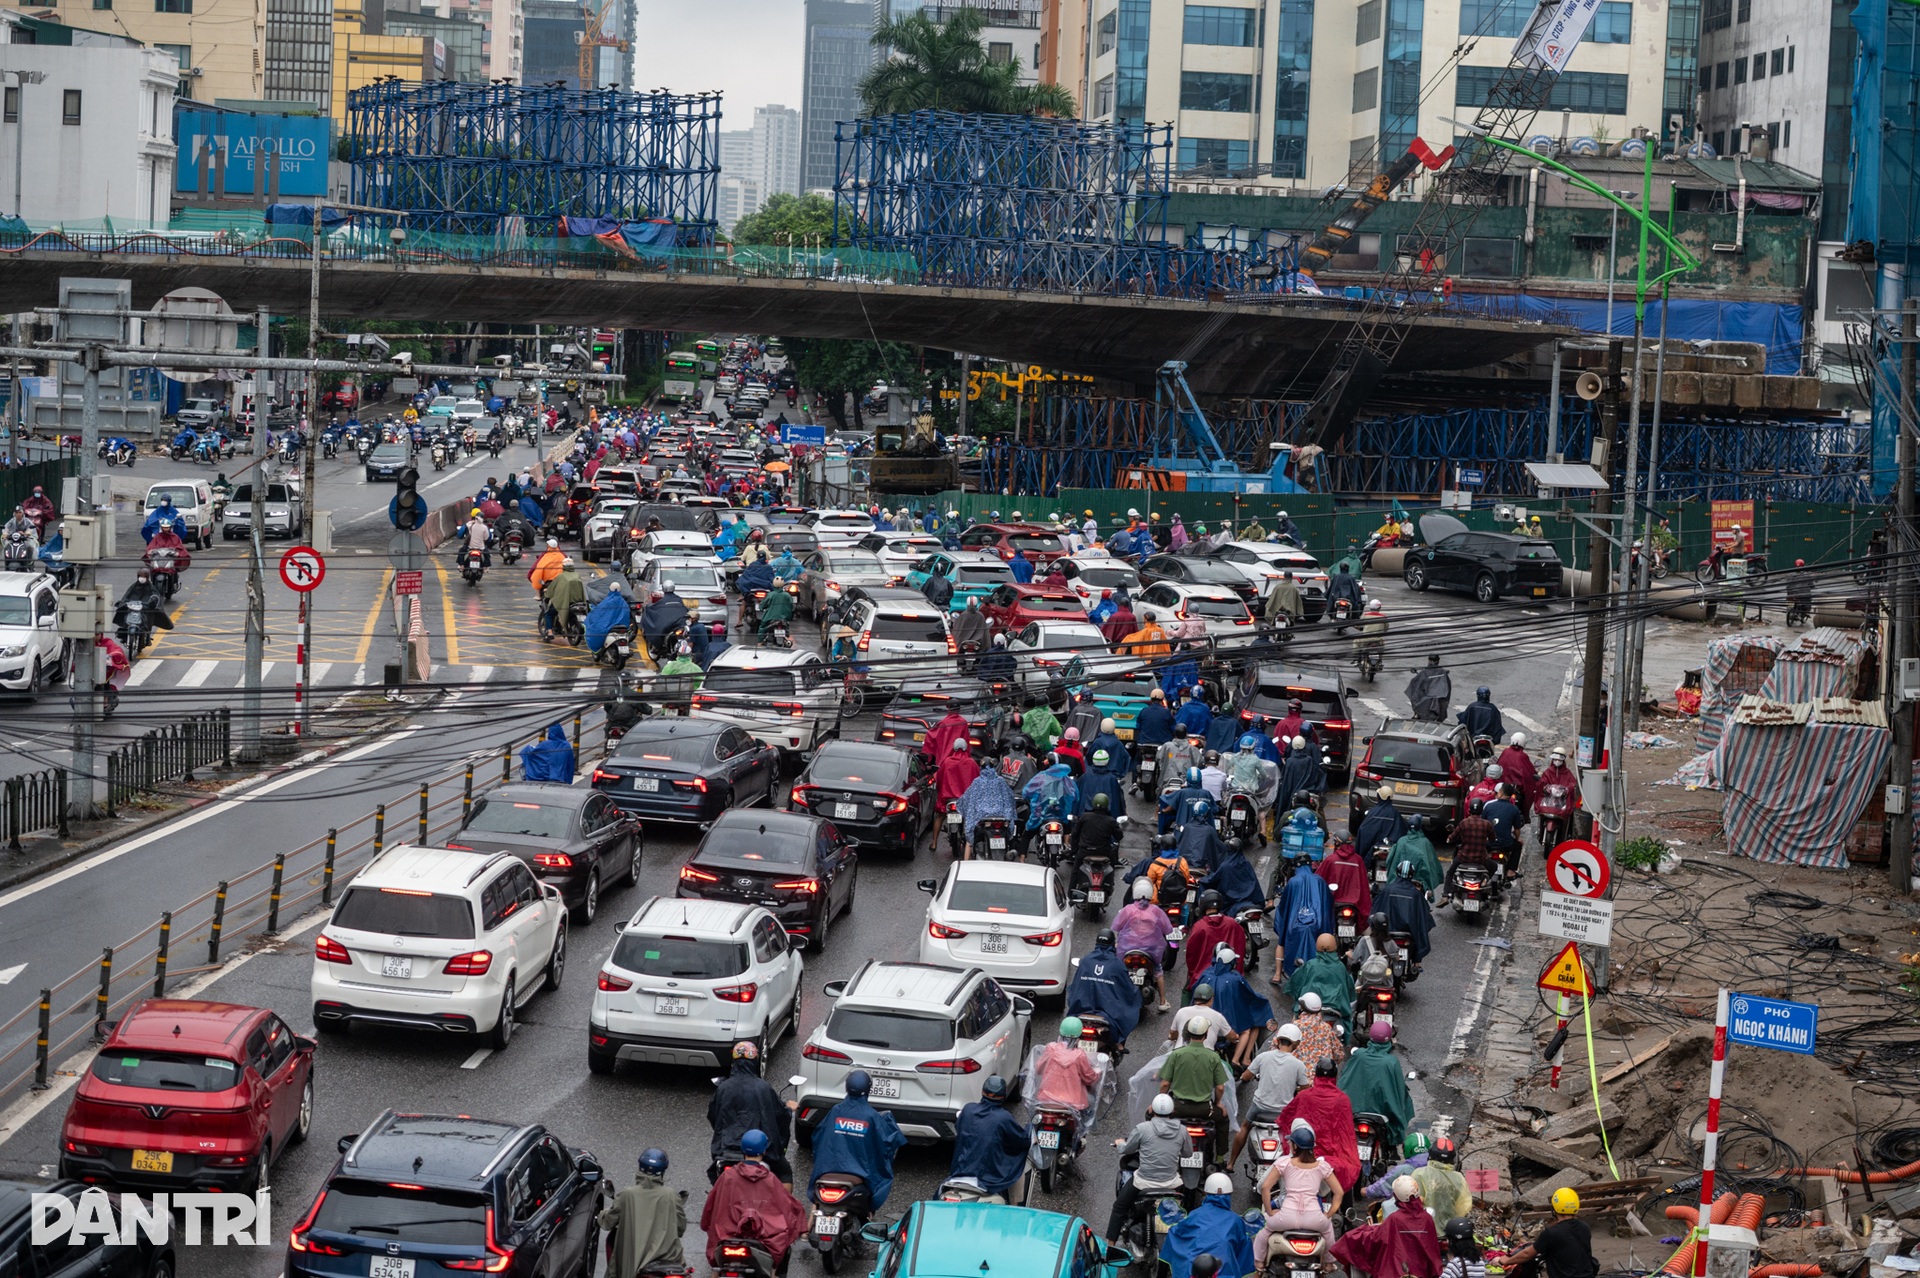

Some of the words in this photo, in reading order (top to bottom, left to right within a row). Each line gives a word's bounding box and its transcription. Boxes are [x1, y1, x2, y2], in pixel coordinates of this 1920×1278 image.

[1551, 20, 1565, 39] CTCP
[234, 137, 315, 157] APOLLO
[1562, 922, 1580, 932] NGOẠI
[1580, 925, 1588, 933] LỆ
[1563, 930, 1586, 940] Except
[382, 966, 410, 977] 456.19
[665, 997, 680, 1006] 30H
[658, 1005, 685, 1015] 368.30
[1764, 1006, 1792, 1019] PHỐ
[1734, 1018, 1765, 1041] NGỌC
[1767, 1022, 1809, 1046] KHÁNH
[875, 1079, 891, 1087] 30G
[839, 1120, 864, 1131] VRB
[144, 1151, 161, 1161] 29K
[136, 1160, 168, 1171] 034.78
[383, 1257, 403, 1268] 30B
[374, 1267, 410, 1278] 534.18
